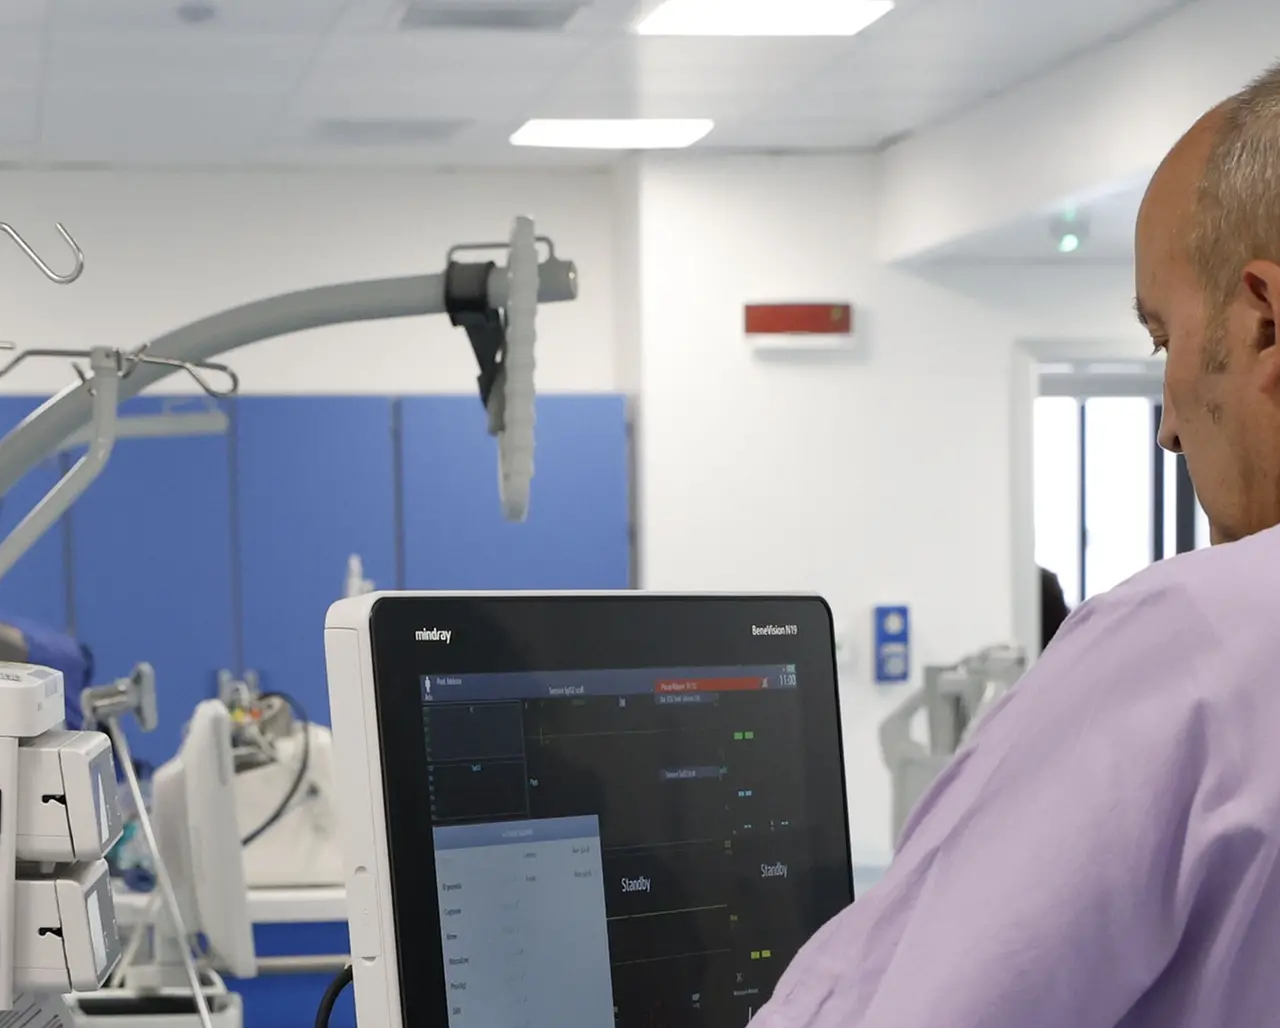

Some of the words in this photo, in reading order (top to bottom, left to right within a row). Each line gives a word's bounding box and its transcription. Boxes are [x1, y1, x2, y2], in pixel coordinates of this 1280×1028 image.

[415, 627, 451, 644] mindray
[751, 625, 785, 636] BeneVision
[785, 624, 798, 635] N19
[779, 674, 796, 686] 11:00
[760, 862, 788, 878] Standby
[621, 876, 651, 893] Standby
